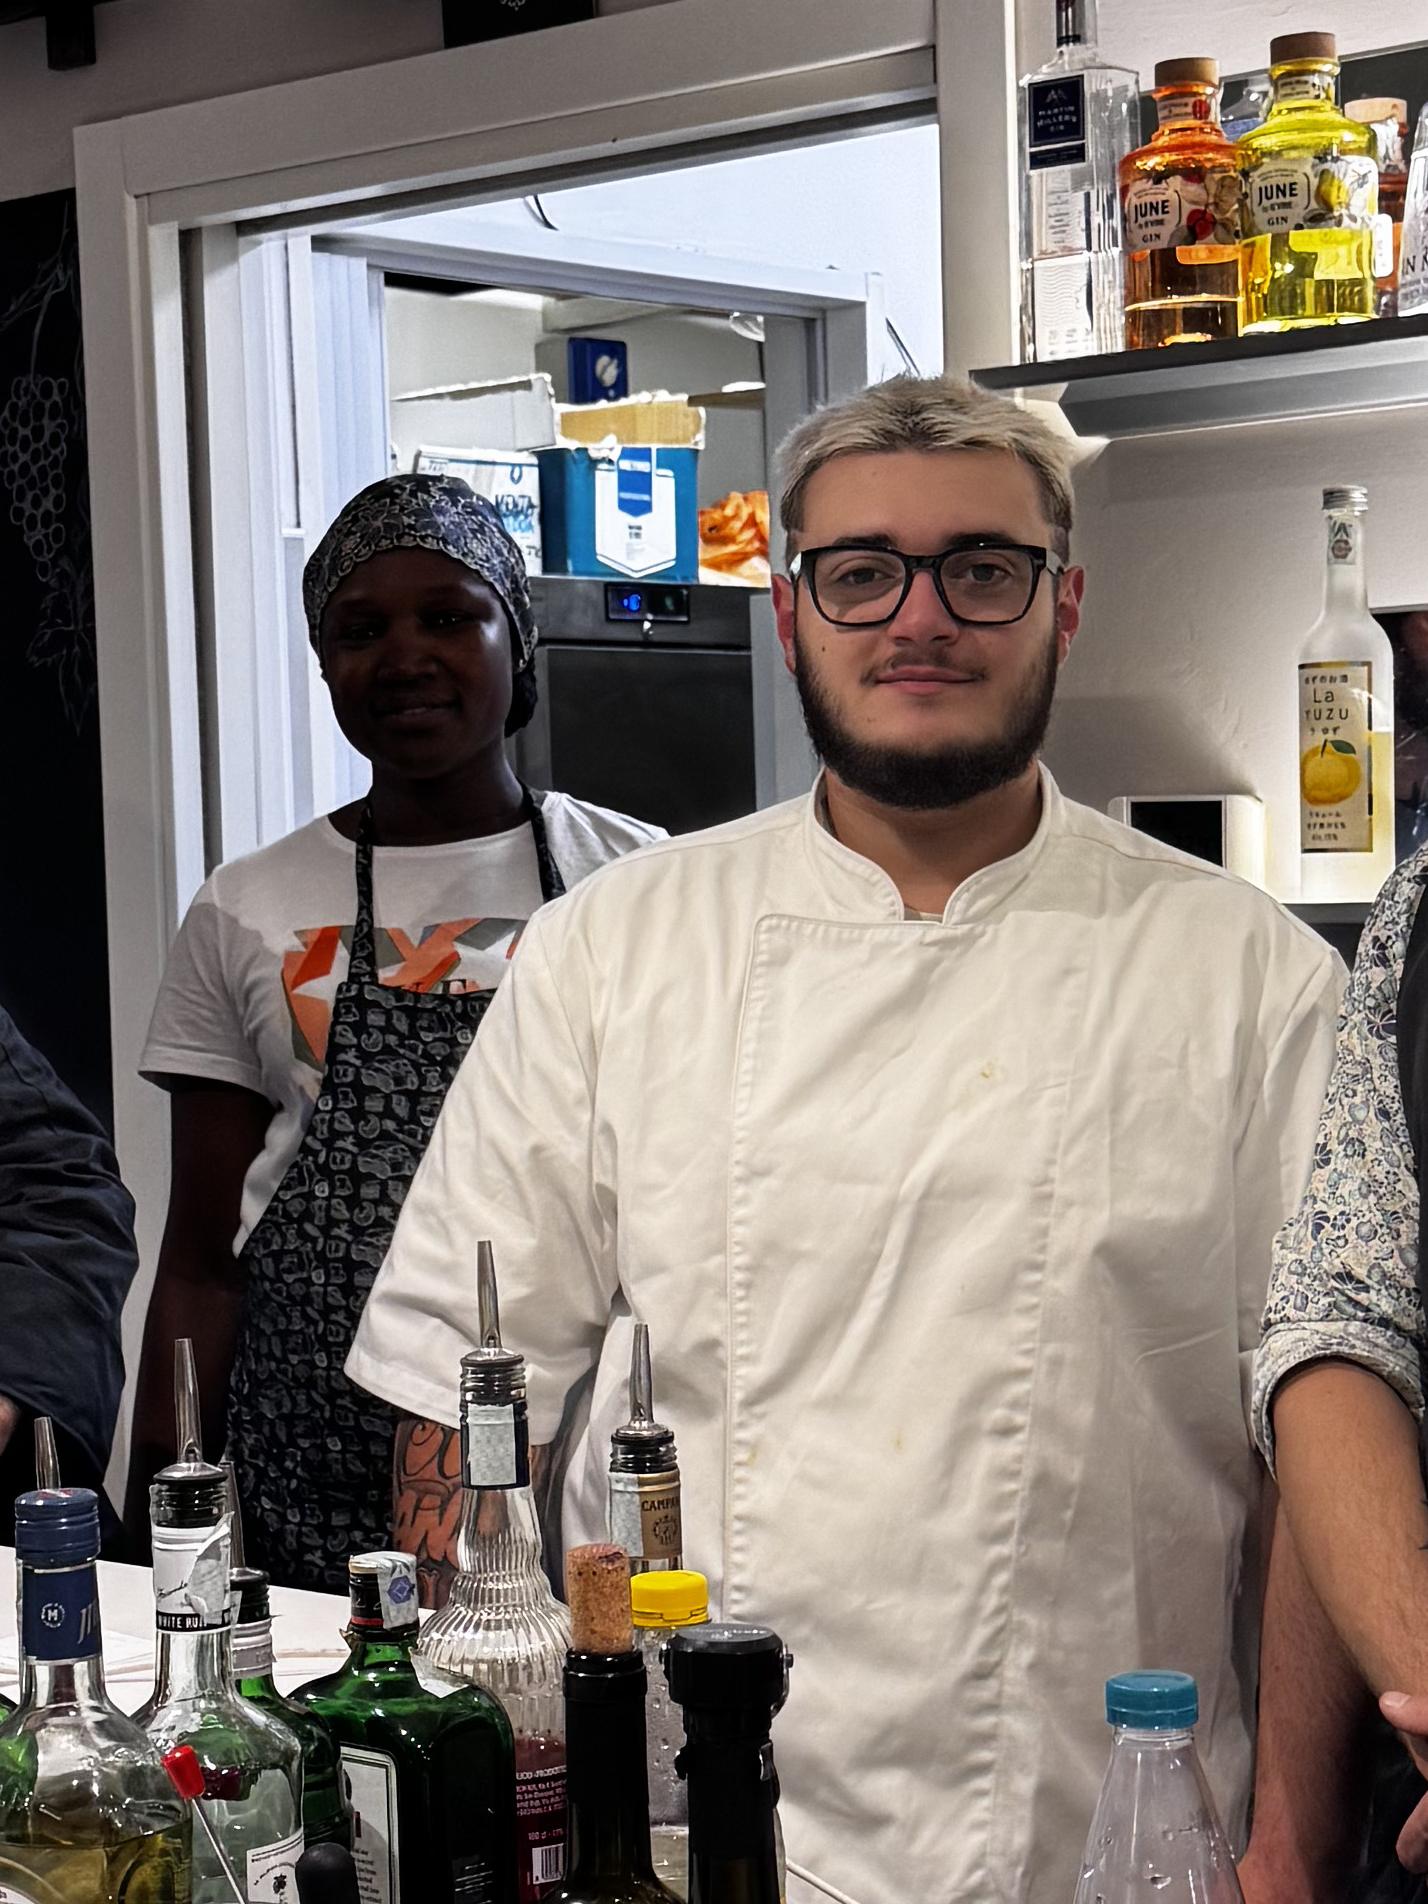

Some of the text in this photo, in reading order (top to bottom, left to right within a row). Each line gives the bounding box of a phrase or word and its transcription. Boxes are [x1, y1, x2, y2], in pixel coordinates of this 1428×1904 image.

[1258, 182, 1299, 206] JUNE
[1134, 199, 1170, 224] JUNE
[1267, 216, 1288, 226] GIN
[1142, 233, 1161, 243] GIN
[1313, 689, 1335, 703] La
[1305, 708, 1349, 722] YUZU
